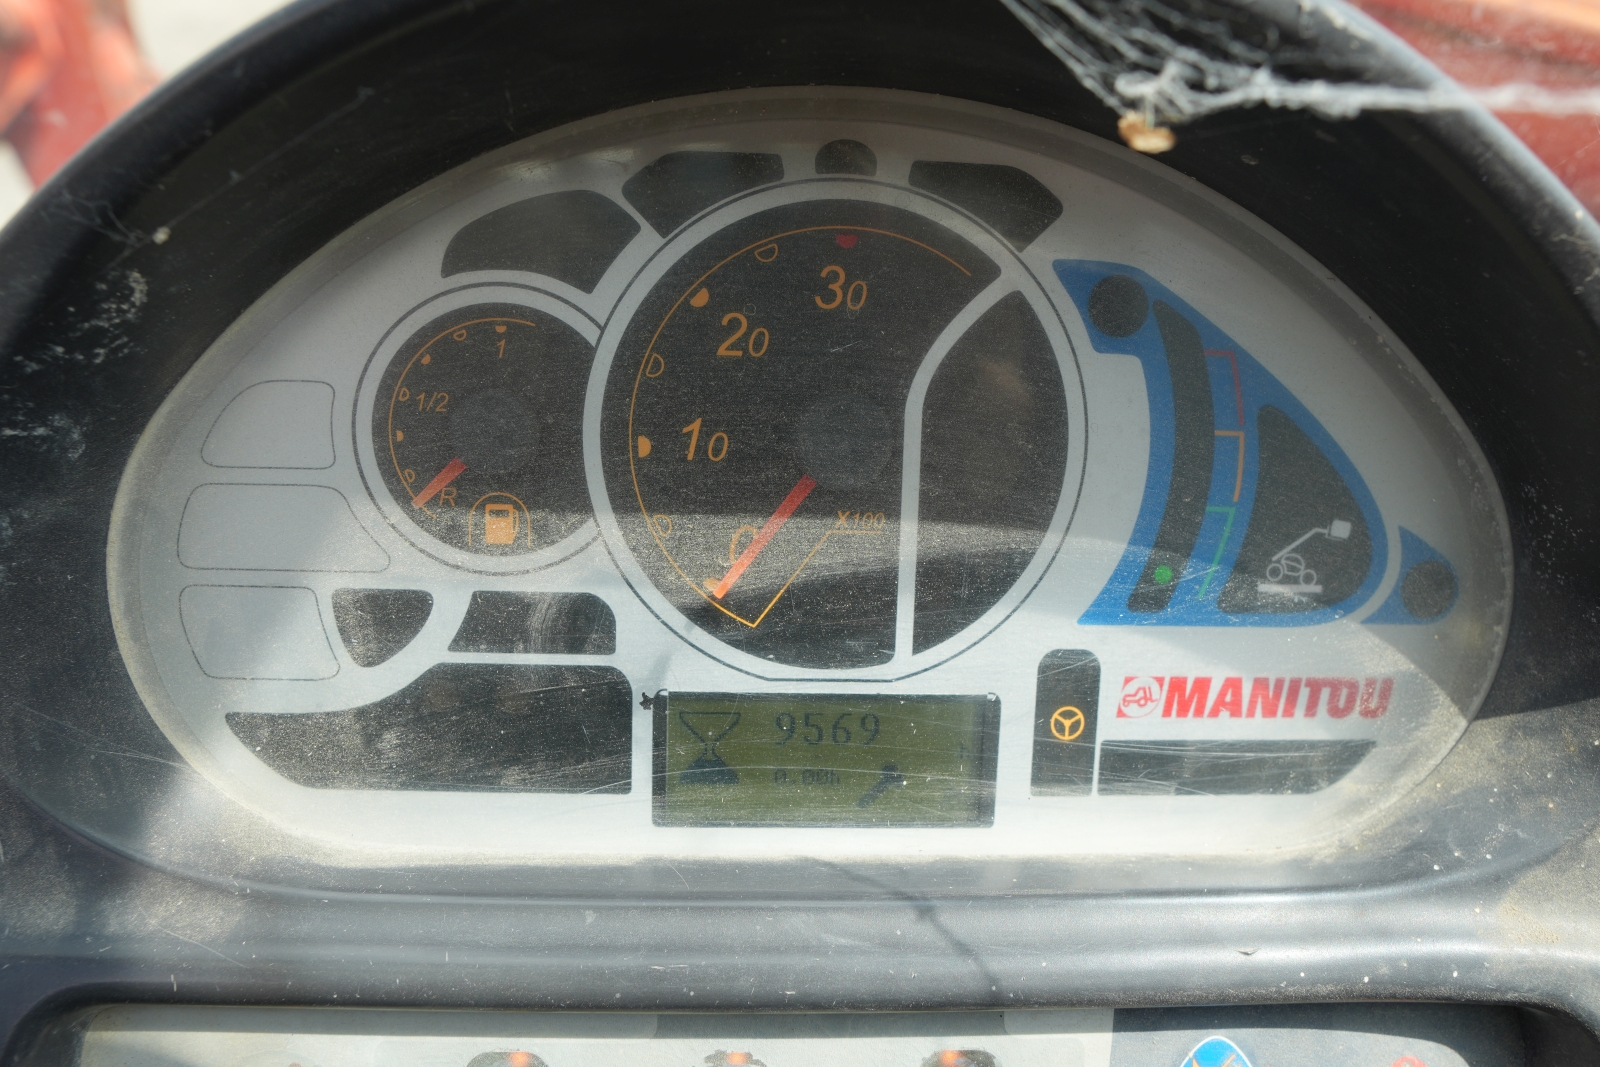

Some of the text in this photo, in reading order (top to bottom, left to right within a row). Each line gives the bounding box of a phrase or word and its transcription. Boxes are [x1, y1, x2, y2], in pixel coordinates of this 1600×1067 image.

[814, 265, 868, 310] 30
[496, 339, 506, 358] 1
[716, 312, 770, 357] 20
[416, 392, 449, 412] 1/2
[681, 417, 729, 462] 10
[439, 487, 457, 506] R
[1161, 676, 1395, 718] MANITOU
[775, 712, 881, 745] 9569
